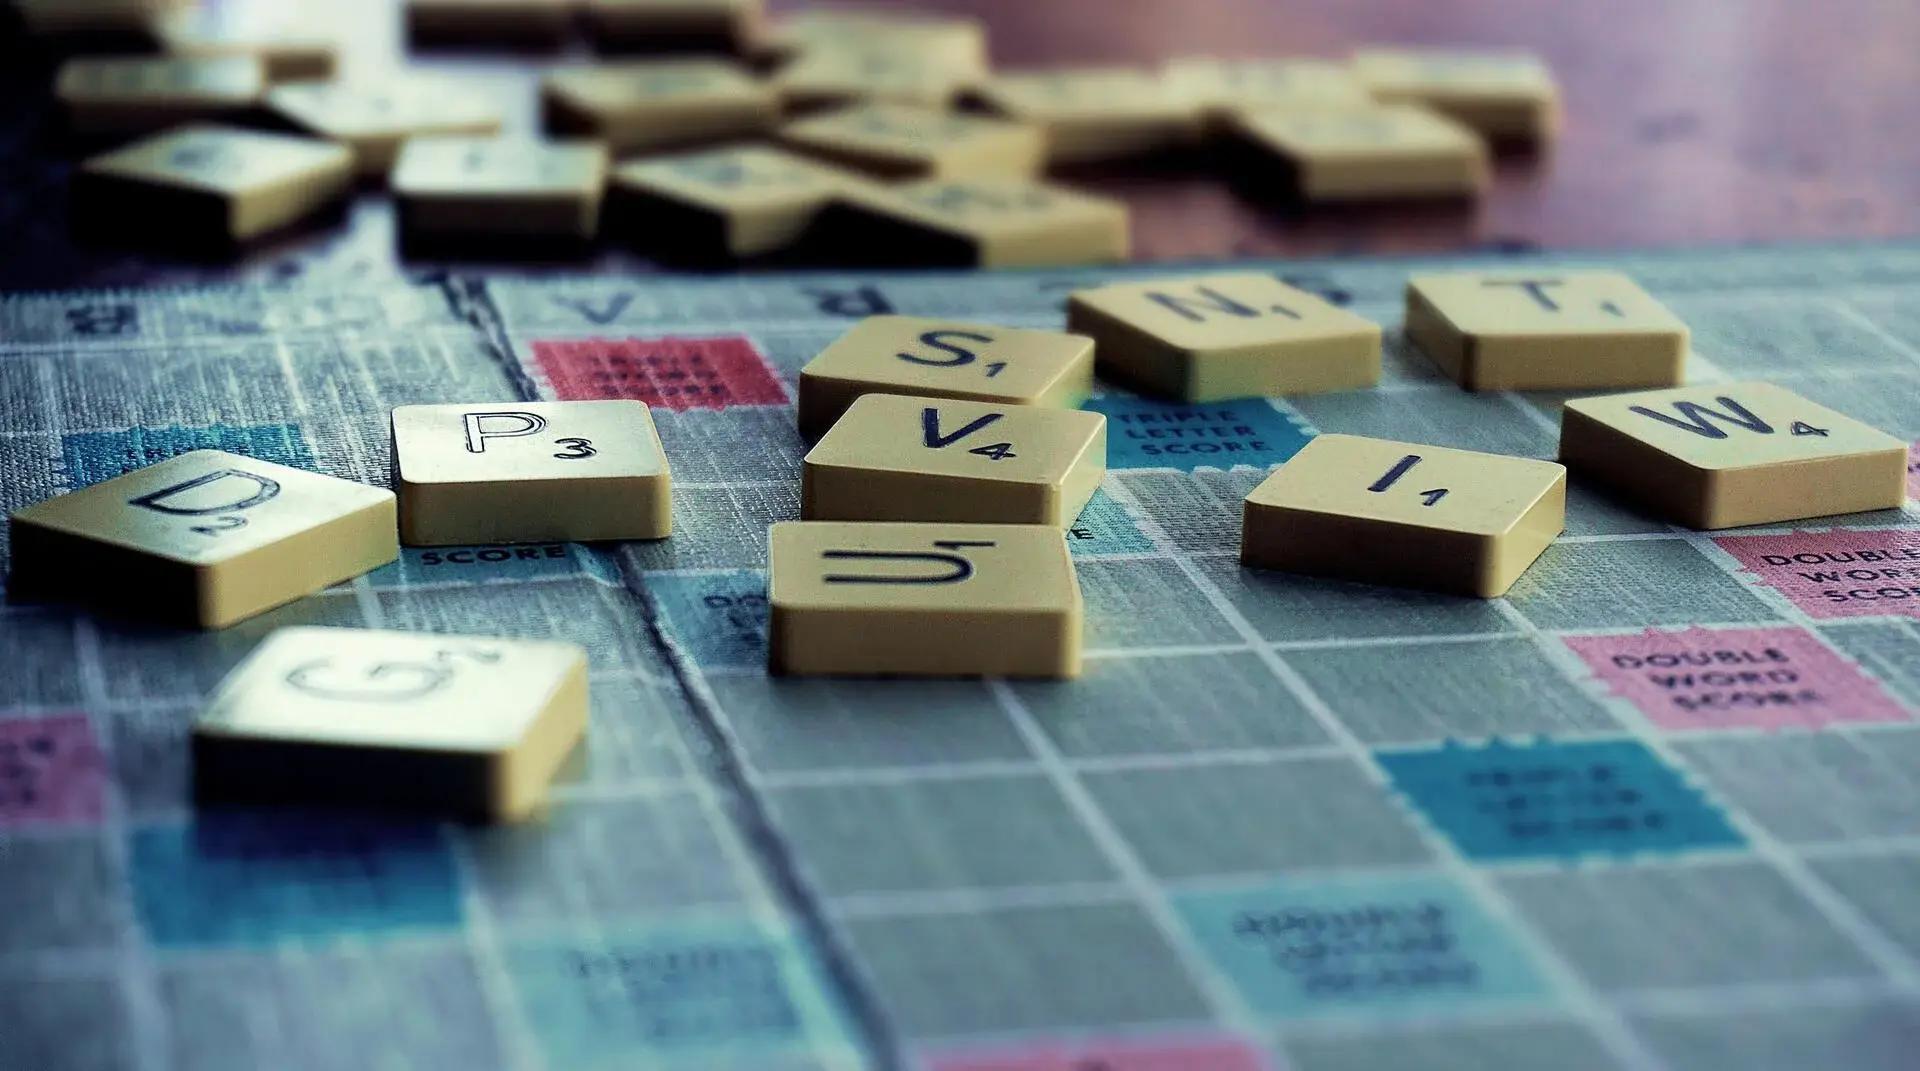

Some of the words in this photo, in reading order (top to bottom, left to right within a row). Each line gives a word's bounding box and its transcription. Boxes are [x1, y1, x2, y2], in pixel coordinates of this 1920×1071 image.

[1144, 285, 1262, 323] N
[1479, 279, 1563, 312] T
[896, 330, 994, 367] S
[985, 362, 1007, 377] 1
[463, 411, 547, 453] P
[553, 437, 597, 459] 3
[921, 407, 1004, 448] V
[968, 443, 1017, 460] 4
[1125, 426, 1257, 440] LETTER
[1629, 396, 1775, 439] W
[1790, 420, 1830, 437] 4
[1141, 440, 1272, 456] SCORE
[128, 468, 281, 516] D
[421, 545, 567, 566] SCORE
[823, 550, 974, 586] U
[1611, 648, 1790, 670] DOUBLE
